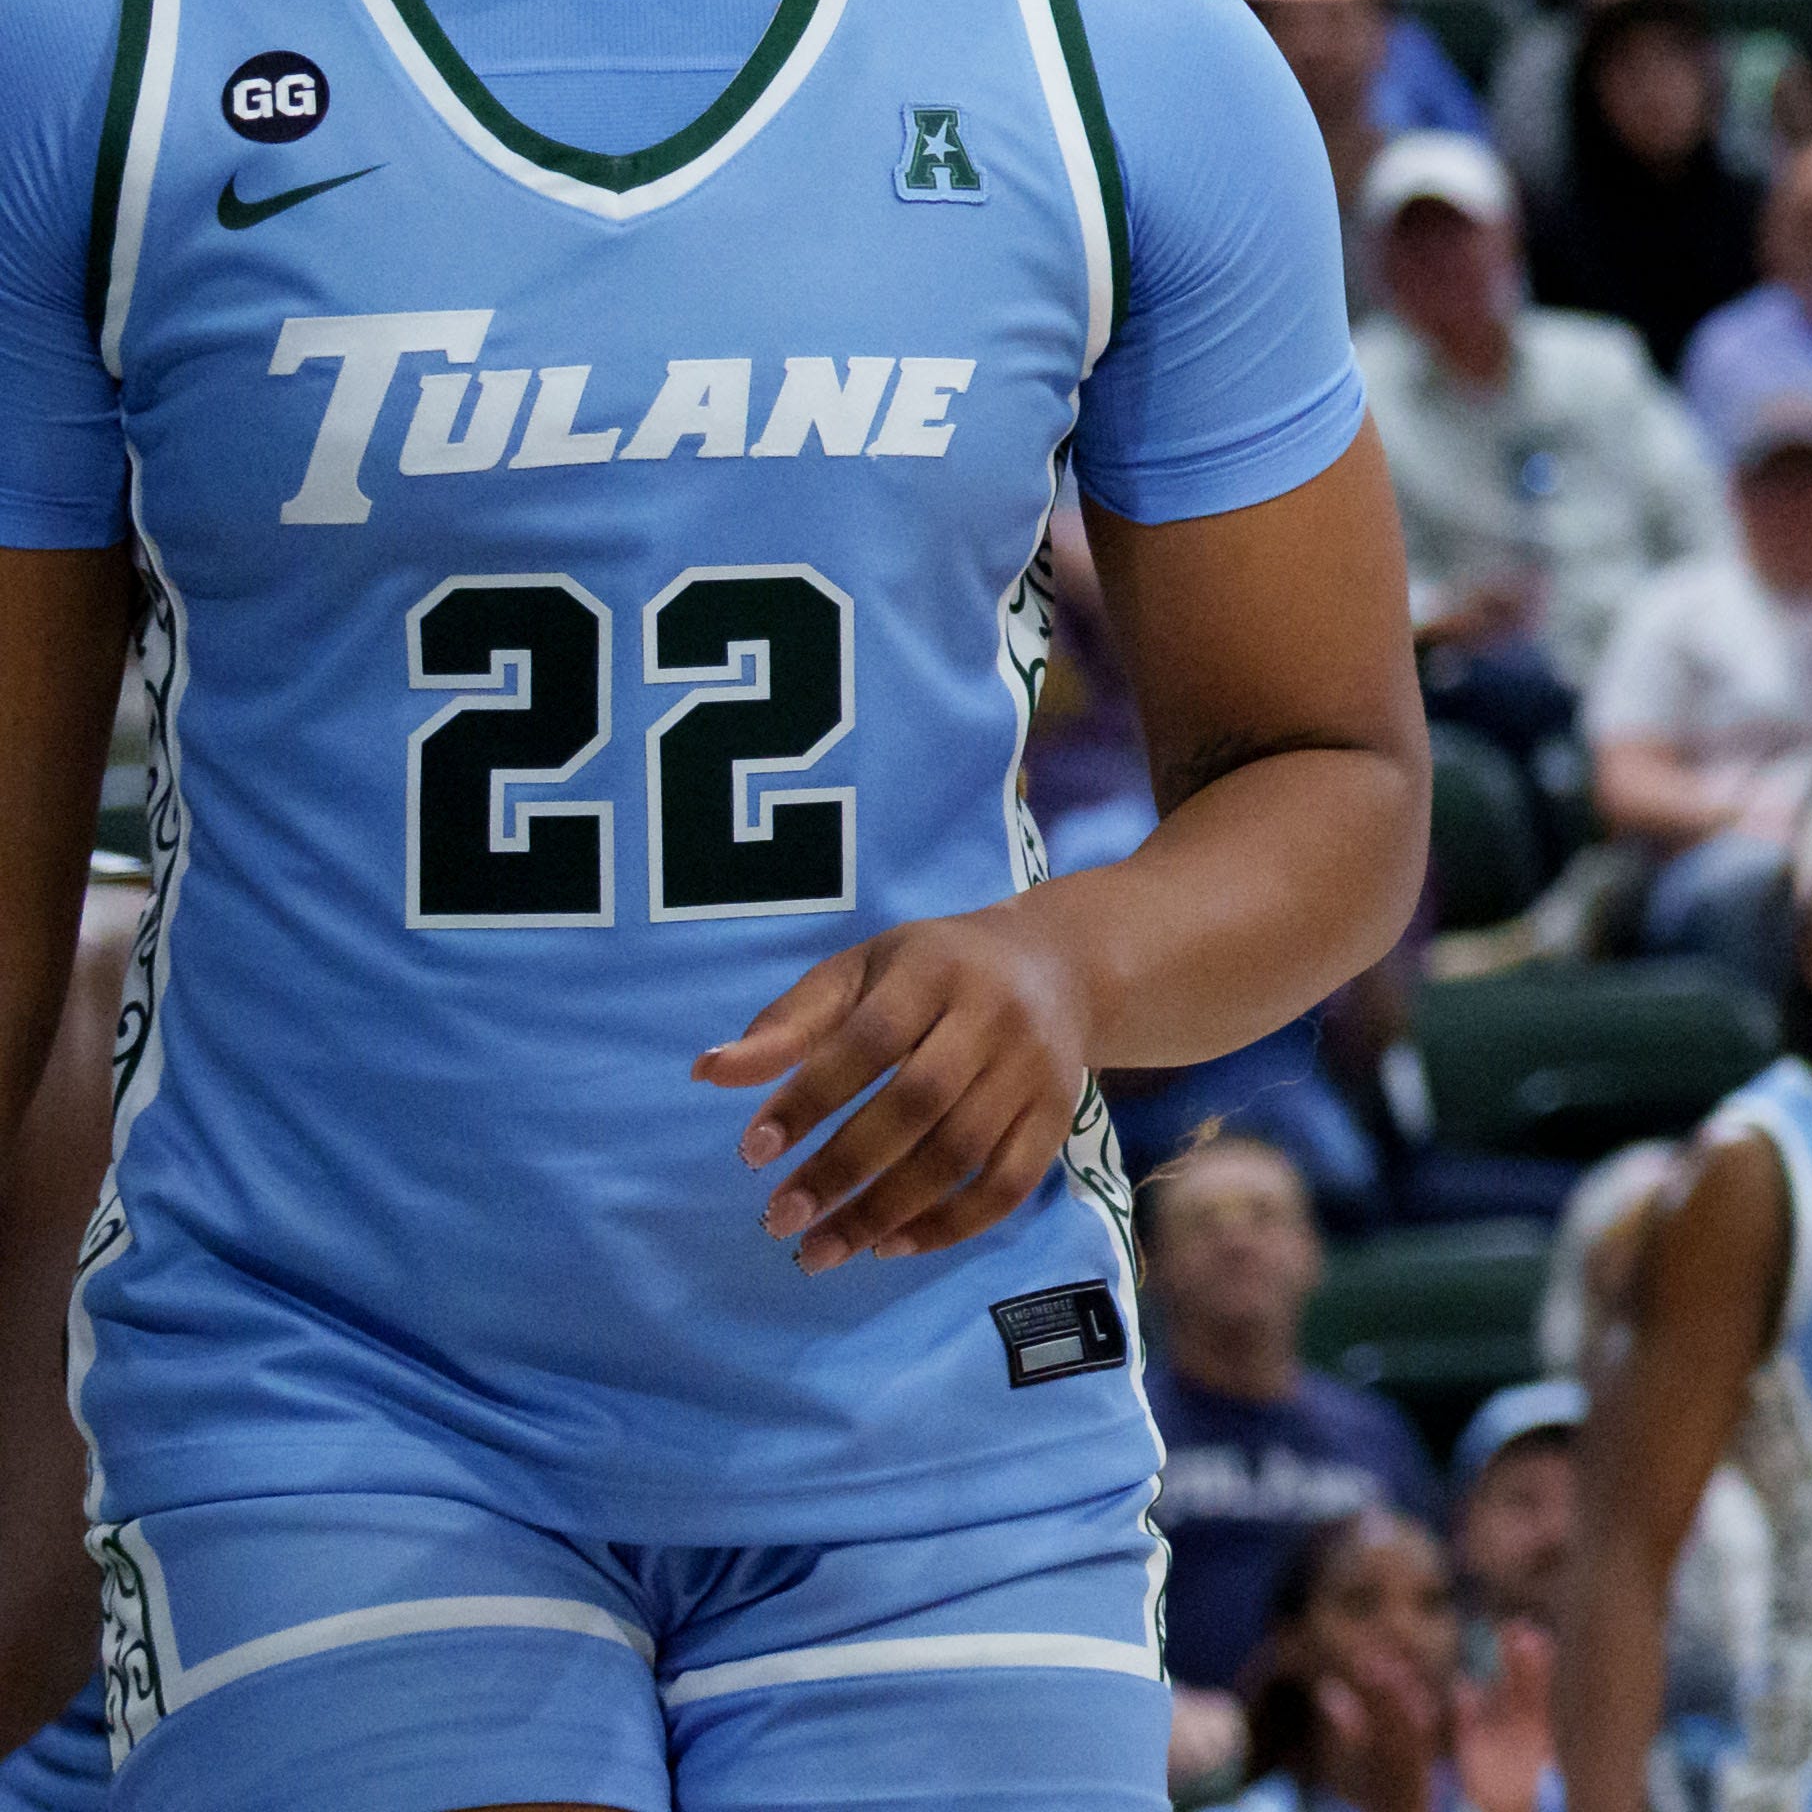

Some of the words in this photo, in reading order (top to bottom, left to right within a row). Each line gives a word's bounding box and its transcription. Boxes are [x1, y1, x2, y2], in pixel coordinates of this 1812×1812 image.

[232, 73, 318, 121] GG
[405, 562, 857, 930] 22
[1088, 1309, 1108, 1342] L
